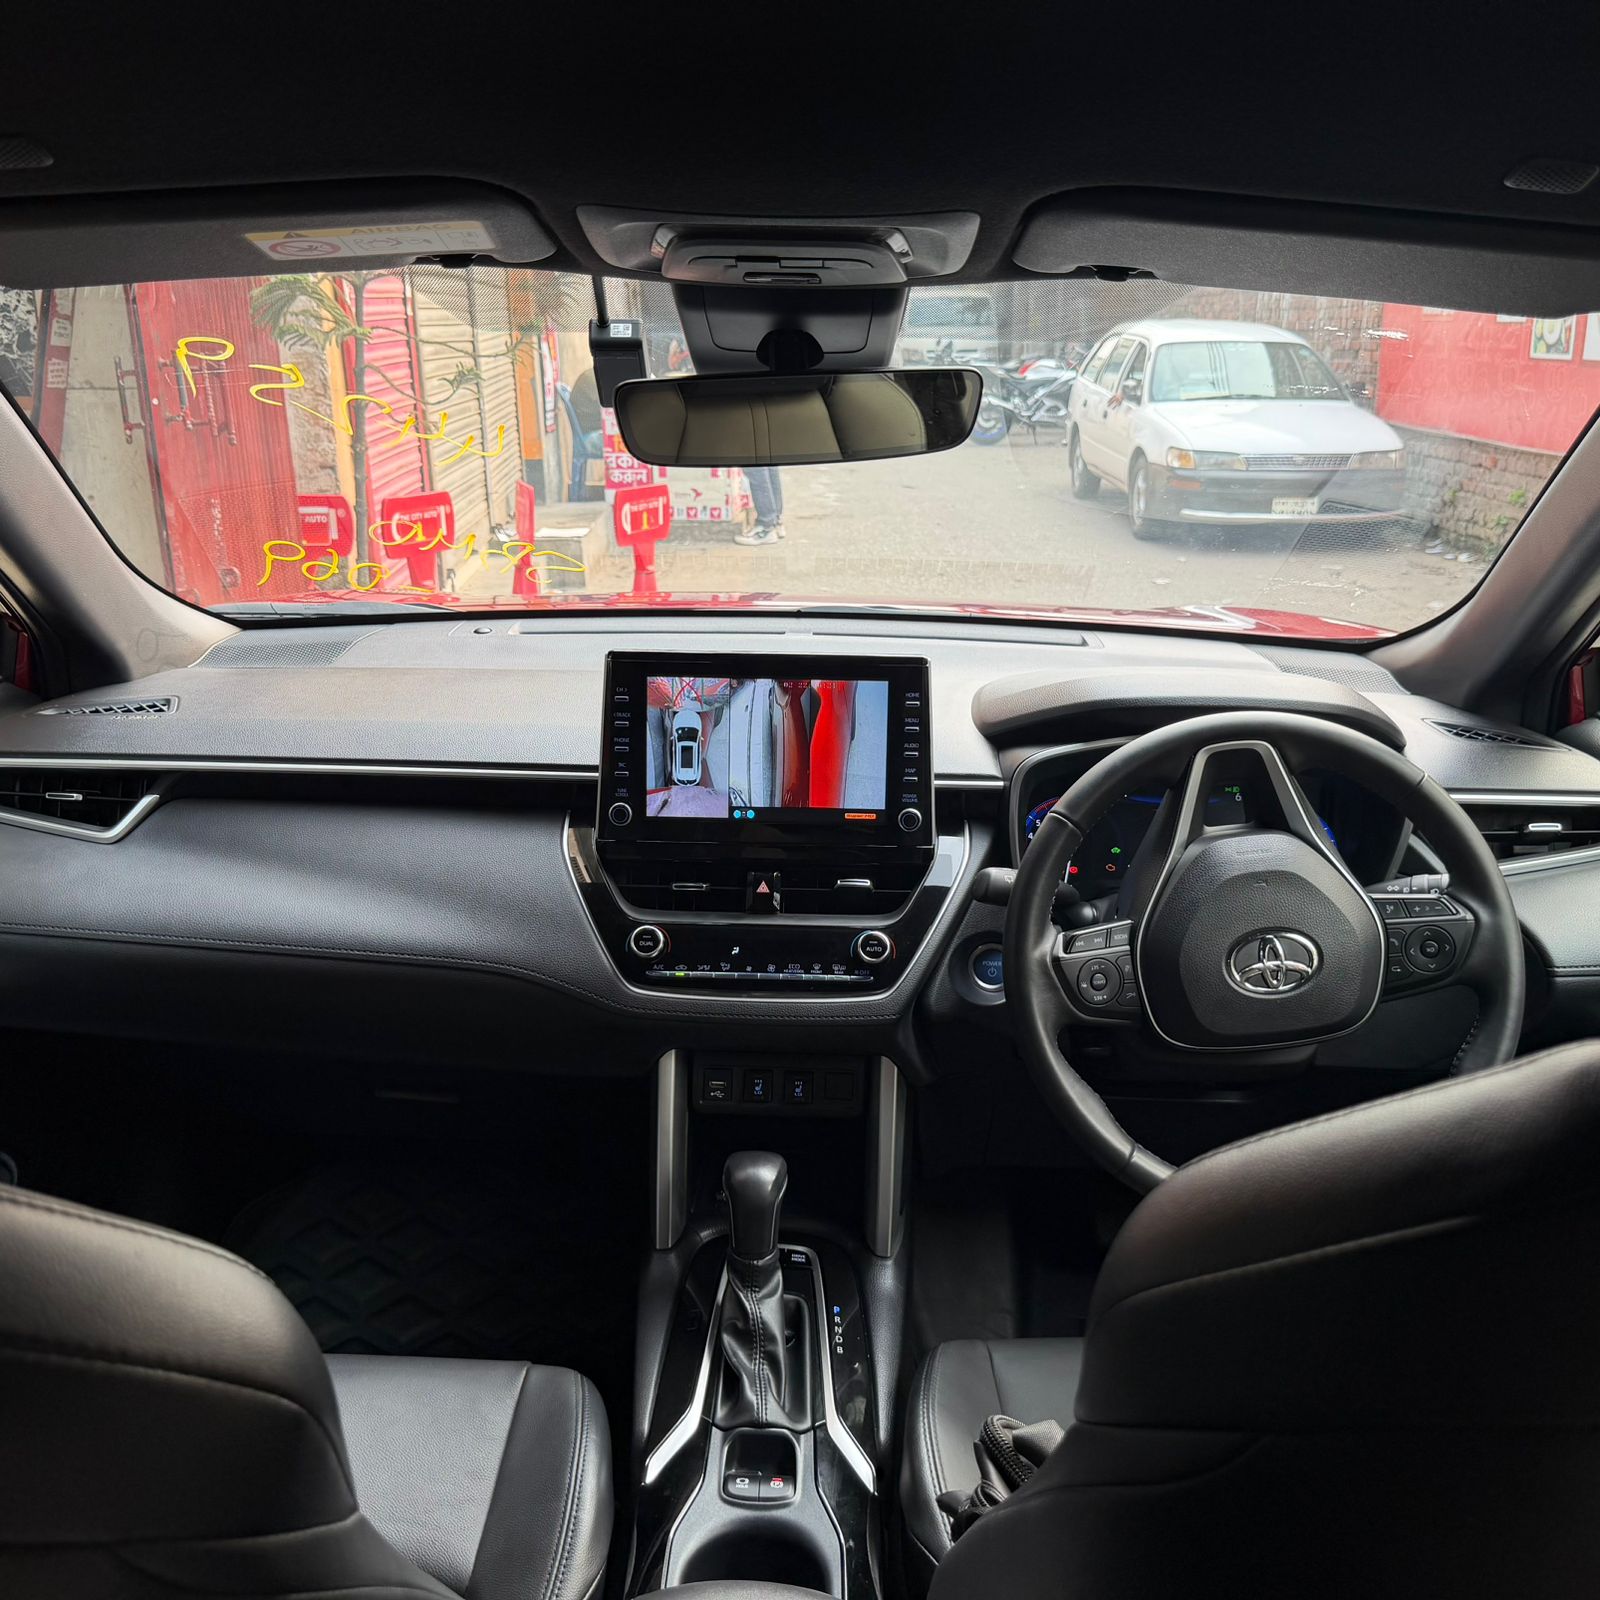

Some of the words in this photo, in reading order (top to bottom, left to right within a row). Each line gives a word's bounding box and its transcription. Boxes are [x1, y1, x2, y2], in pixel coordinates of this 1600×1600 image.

[351, 223, 450, 235] AIRBAG
[834, 1326, 842, 1334] N
[835, 1335, 843, 1343] D
[836, 1346, 844, 1354] B
